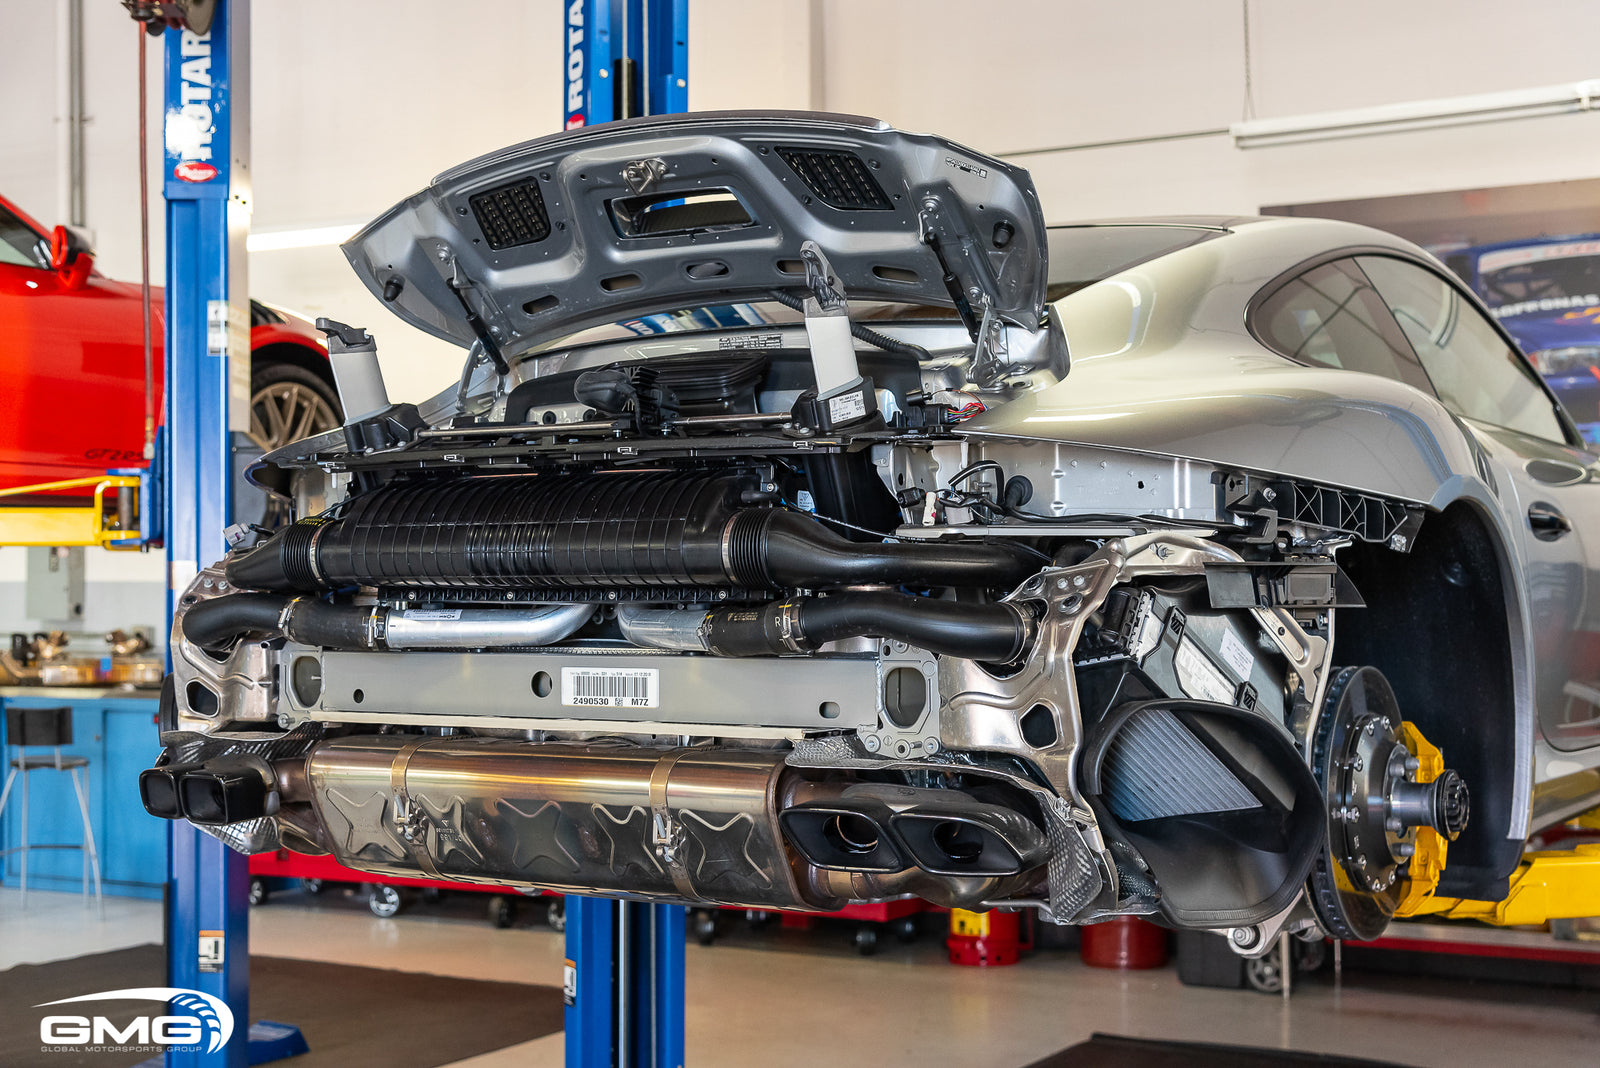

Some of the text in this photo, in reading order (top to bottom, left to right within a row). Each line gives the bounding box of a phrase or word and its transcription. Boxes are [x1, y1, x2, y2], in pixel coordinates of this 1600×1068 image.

[774, 616, 781, 628] R
[573, 697, 649, 707] 2490530 M7Z
